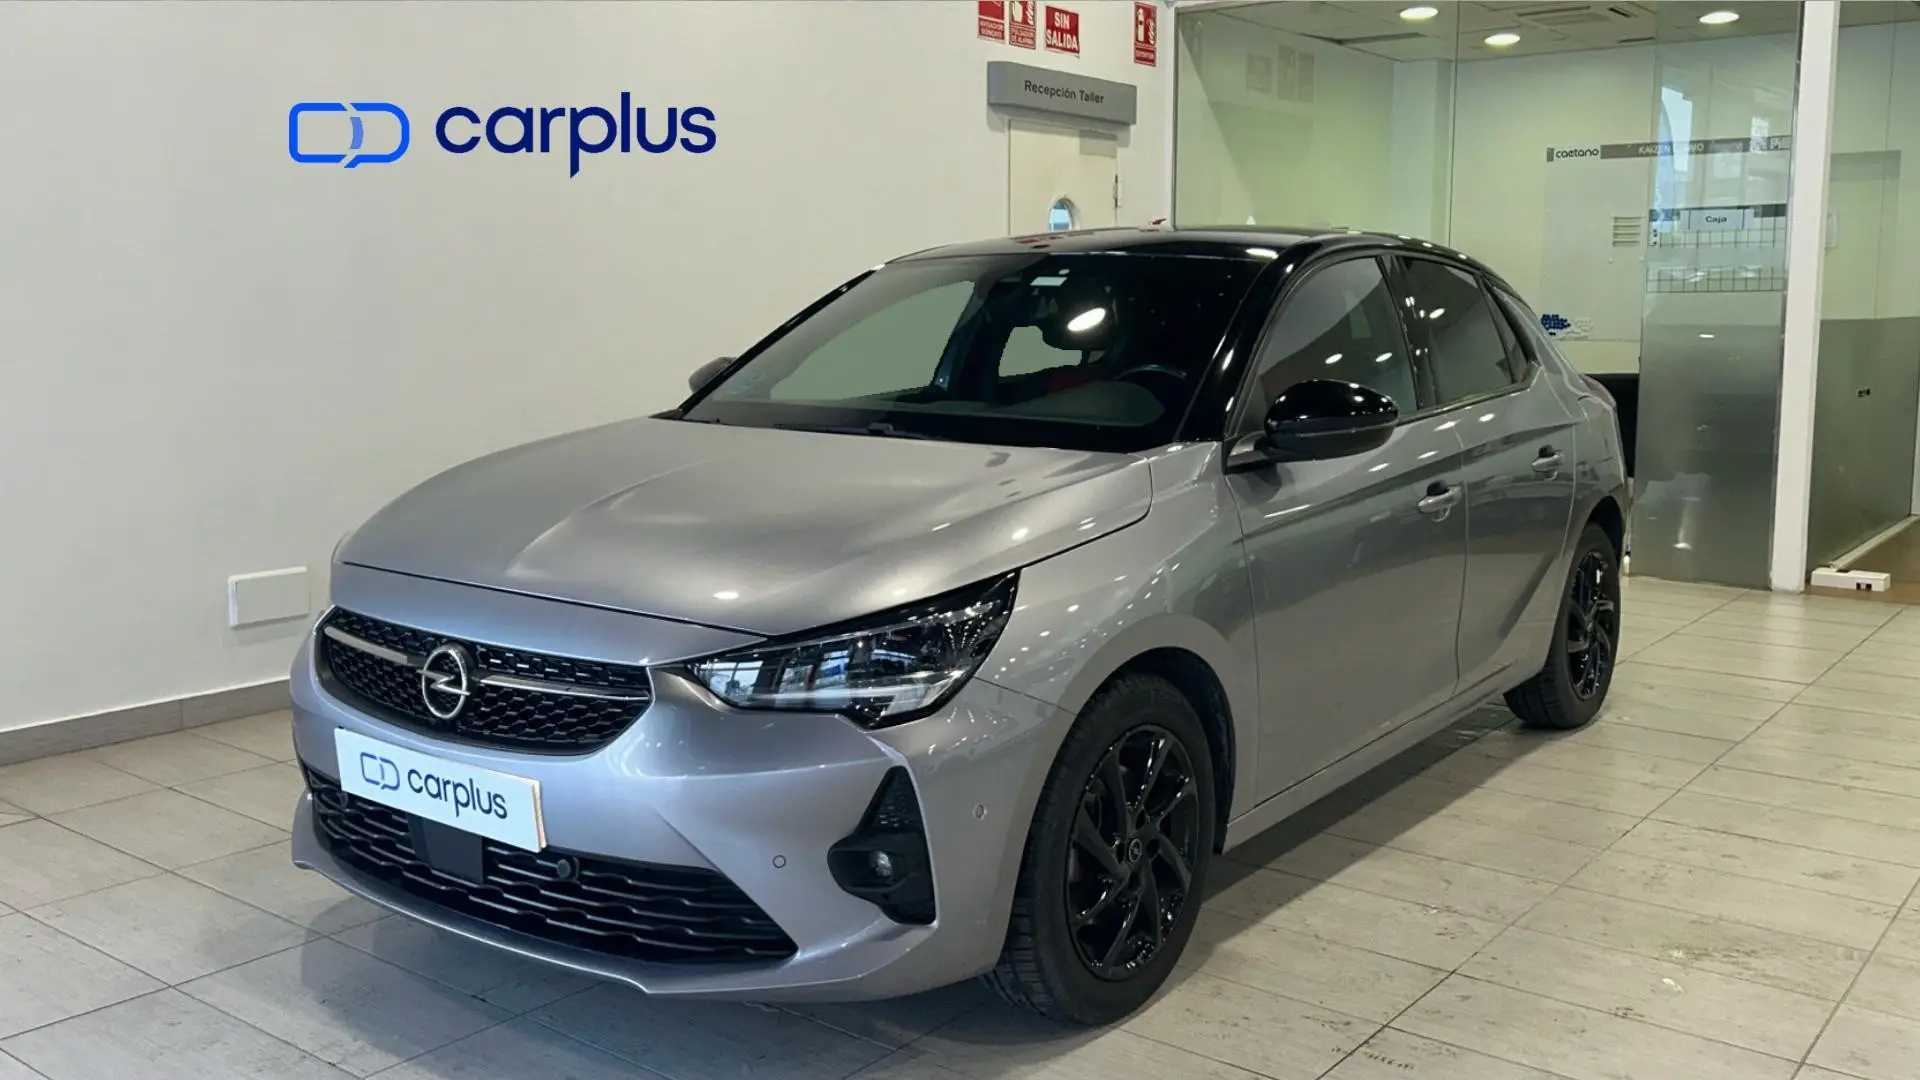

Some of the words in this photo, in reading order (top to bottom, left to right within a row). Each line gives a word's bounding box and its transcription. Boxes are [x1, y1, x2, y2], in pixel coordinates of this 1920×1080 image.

[1054, 12, 1070, 30] SIN
[1046, 28, 1079, 51] SALIDA
[1024, 80, 1076, 100] Recepción
[1079, 90, 1104, 104] Taller
[1555, 147, 1599, 159] caetano
[1705, 214, 1728, 225] Caja
[407, 768, 508, 820] carplus
